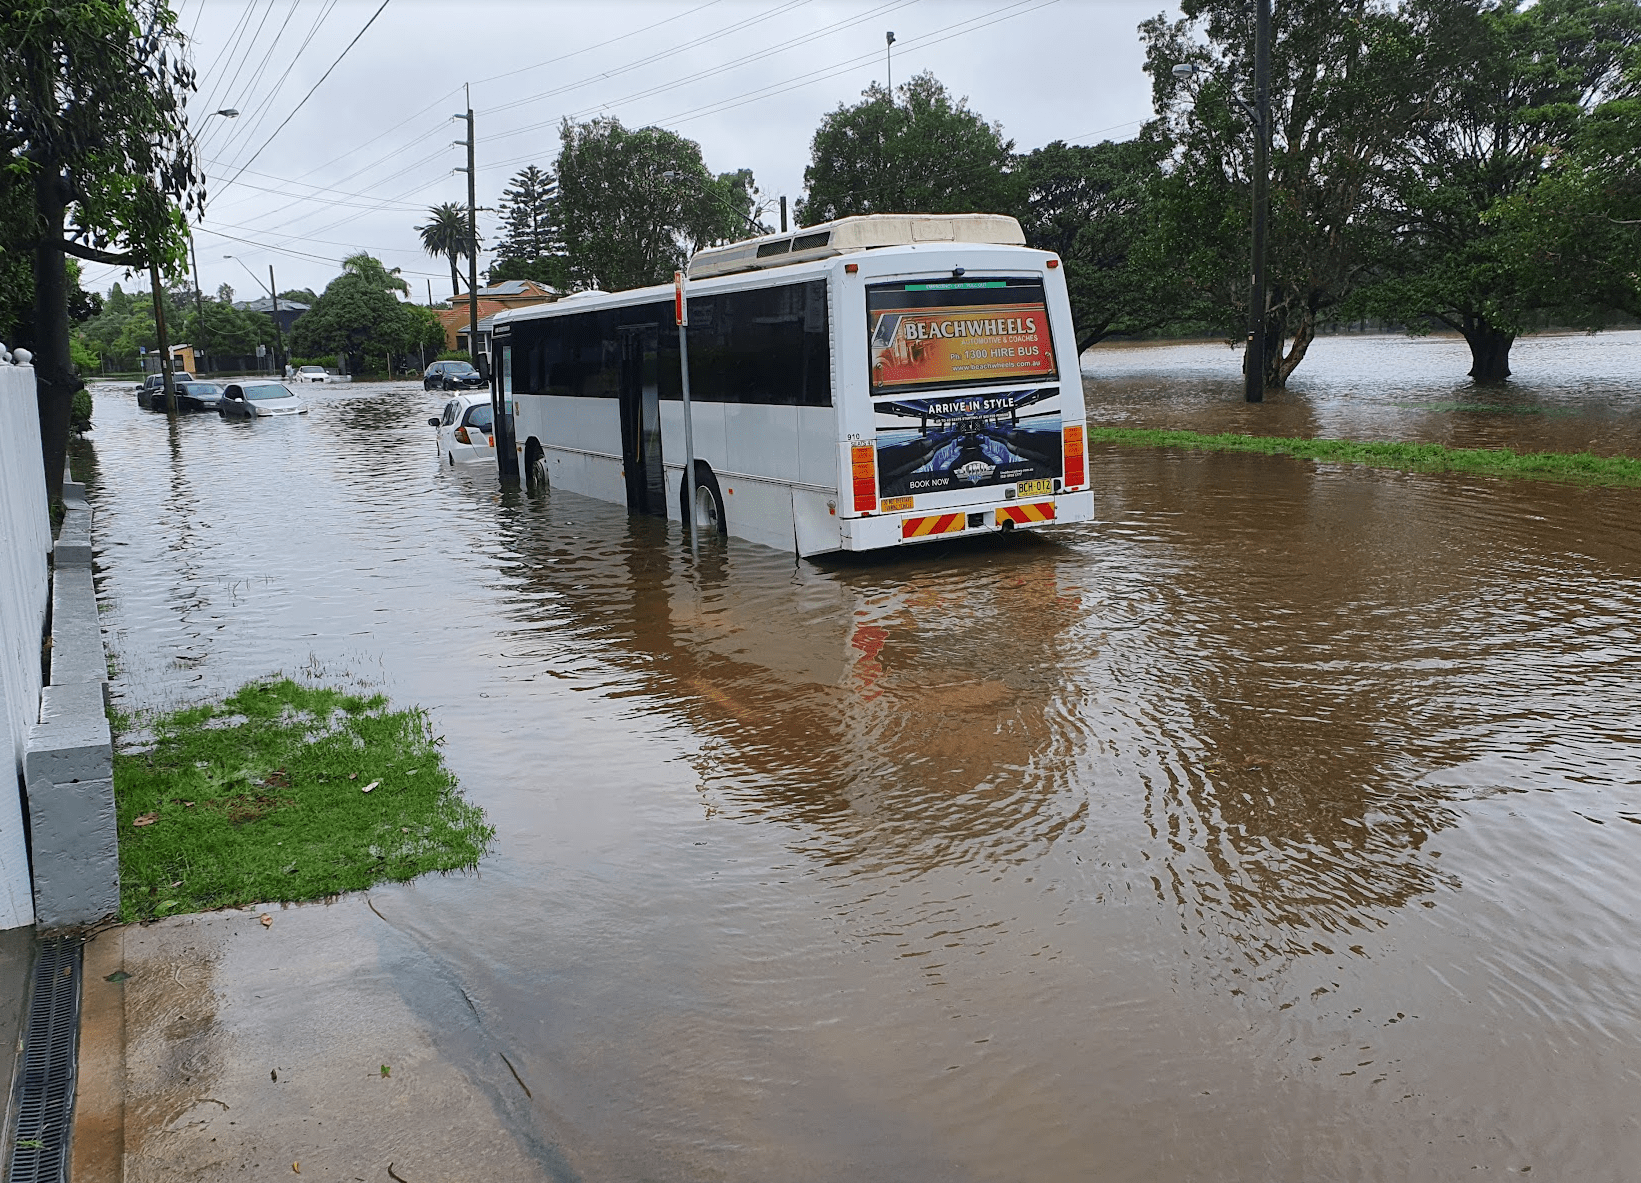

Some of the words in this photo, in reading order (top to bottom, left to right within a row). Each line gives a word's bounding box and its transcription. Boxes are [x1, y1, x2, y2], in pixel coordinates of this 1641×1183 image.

[905, 317, 1037, 340] BEACHWHEELS
[961, 336, 1002, 345] AUTOMOTIVE
[1008, 334, 1039, 342] COACHES
[964, 349, 988, 359] 1300
[990, 347, 1016, 358] HIRE
[1017, 345, 1039, 356] BUS
[952, 360, 1041, 371] www.beachwheels.com.au
[928, 401, 967, 414] ARRIVE
[969, 400, 981, 411] IN
[983, 397, 1015, 409] STYLE
[847, 433, 860, 441] 910
[909, 478, 931, 489] BOOK
[931, 477, 950, 487] NOW
